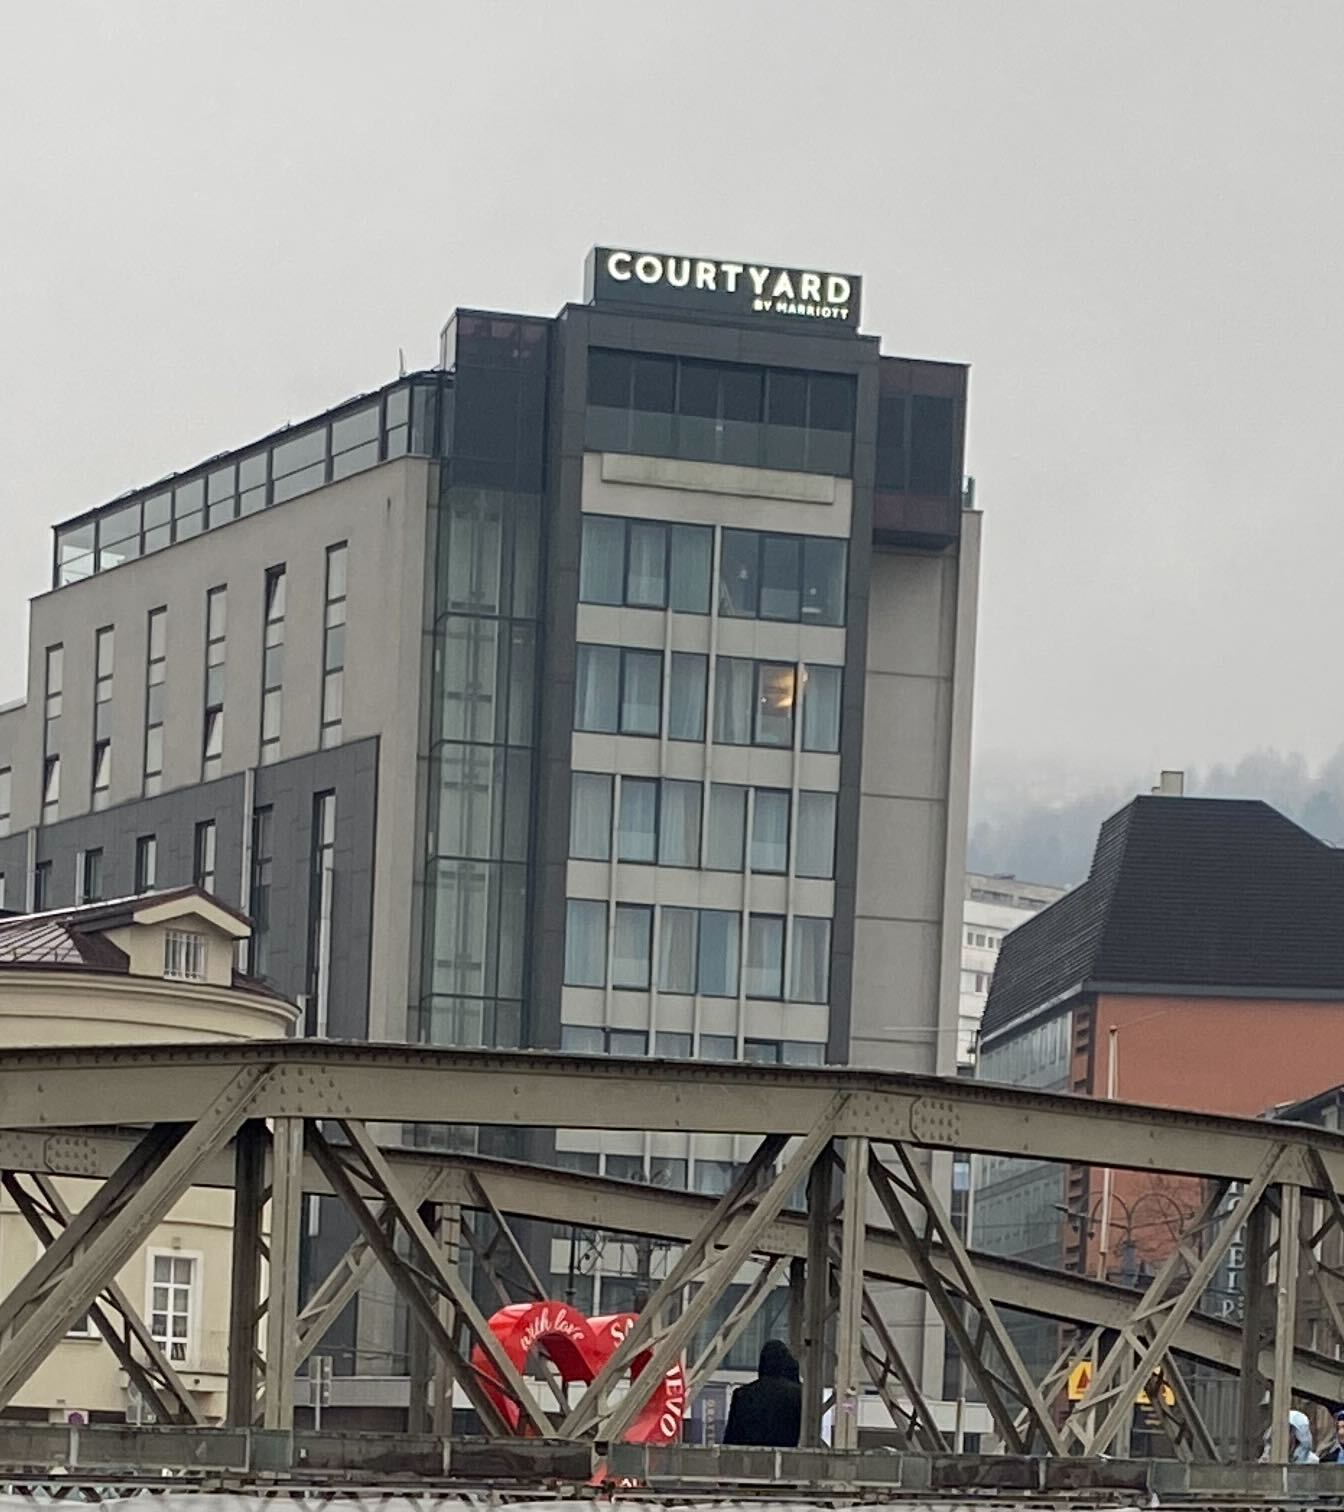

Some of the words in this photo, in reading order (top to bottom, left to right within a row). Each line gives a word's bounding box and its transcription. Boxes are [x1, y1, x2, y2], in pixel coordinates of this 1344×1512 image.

[607, 251, 851, 304] COURTYARD
[753, 299, 772, 311] BY
[776, 302, 849, 320] MARRIOTT
[519, 1306, 552, 1351] with
[554, 1307, 586, 1342] love
